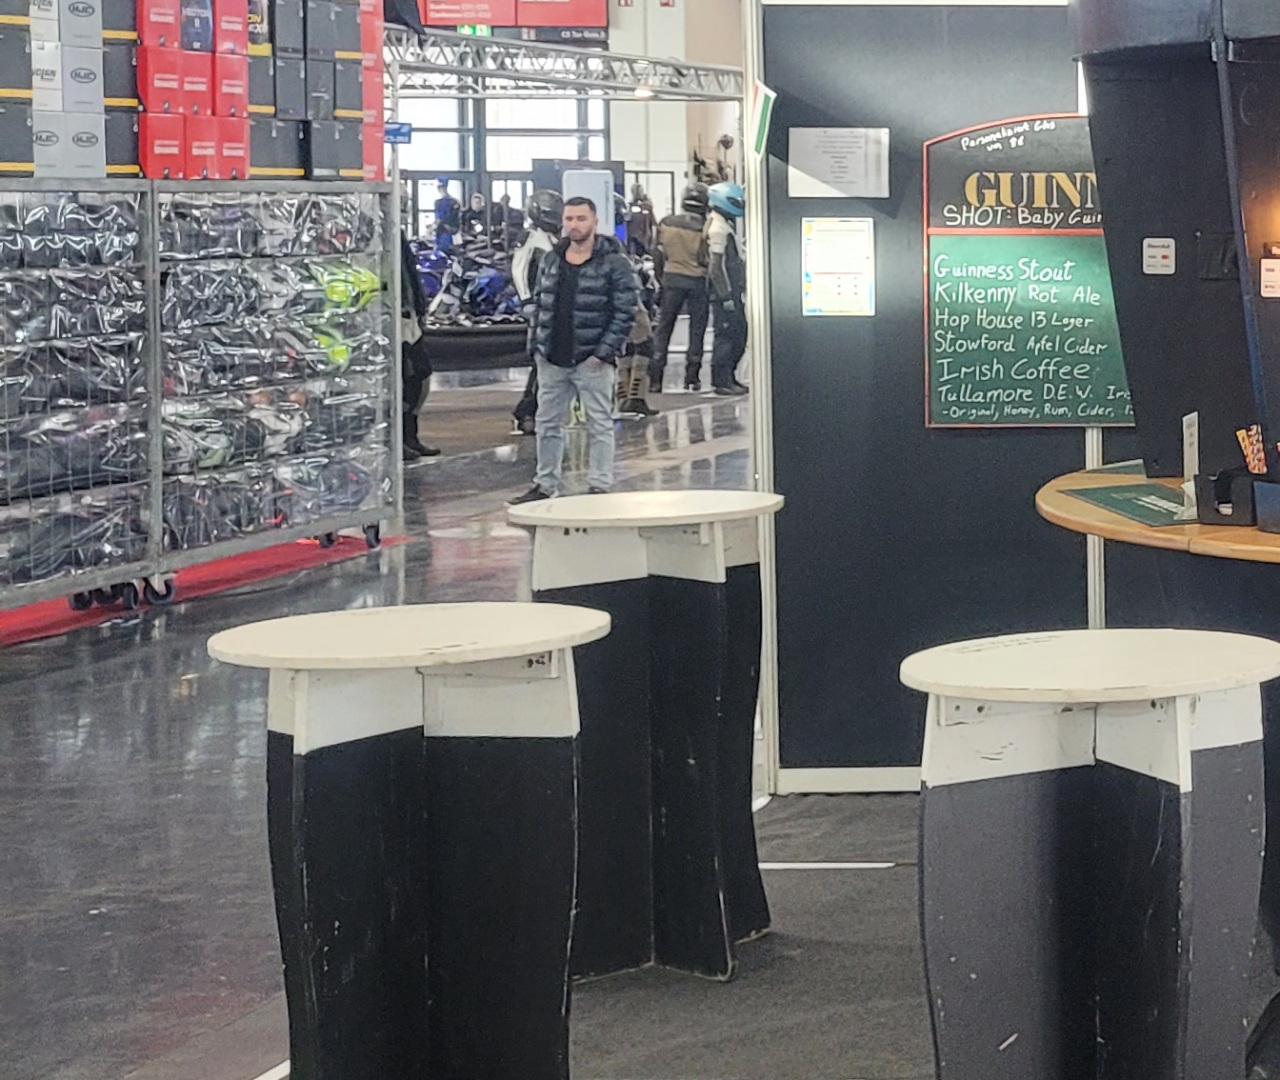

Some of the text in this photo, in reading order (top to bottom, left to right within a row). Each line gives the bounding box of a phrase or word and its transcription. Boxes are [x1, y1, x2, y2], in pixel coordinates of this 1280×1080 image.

[1017, 207, 1065, 230] Baby
[933, 253, 1077, 283] Guinness Stout
[934, 281, 1102, 313] Kilkenny Rot Ale
[934, 307, 970, 333] Hop
[975, 307, 1025, 330] House
[1030, 310, 1048, 329] 13
[934, 329, 1016, 354] Stowford
[1064, 336, 1109, 356] Cider
[936, 357, 1092, 383] Irish Coffee
[937, 383, 1034, 404] Tullamore
